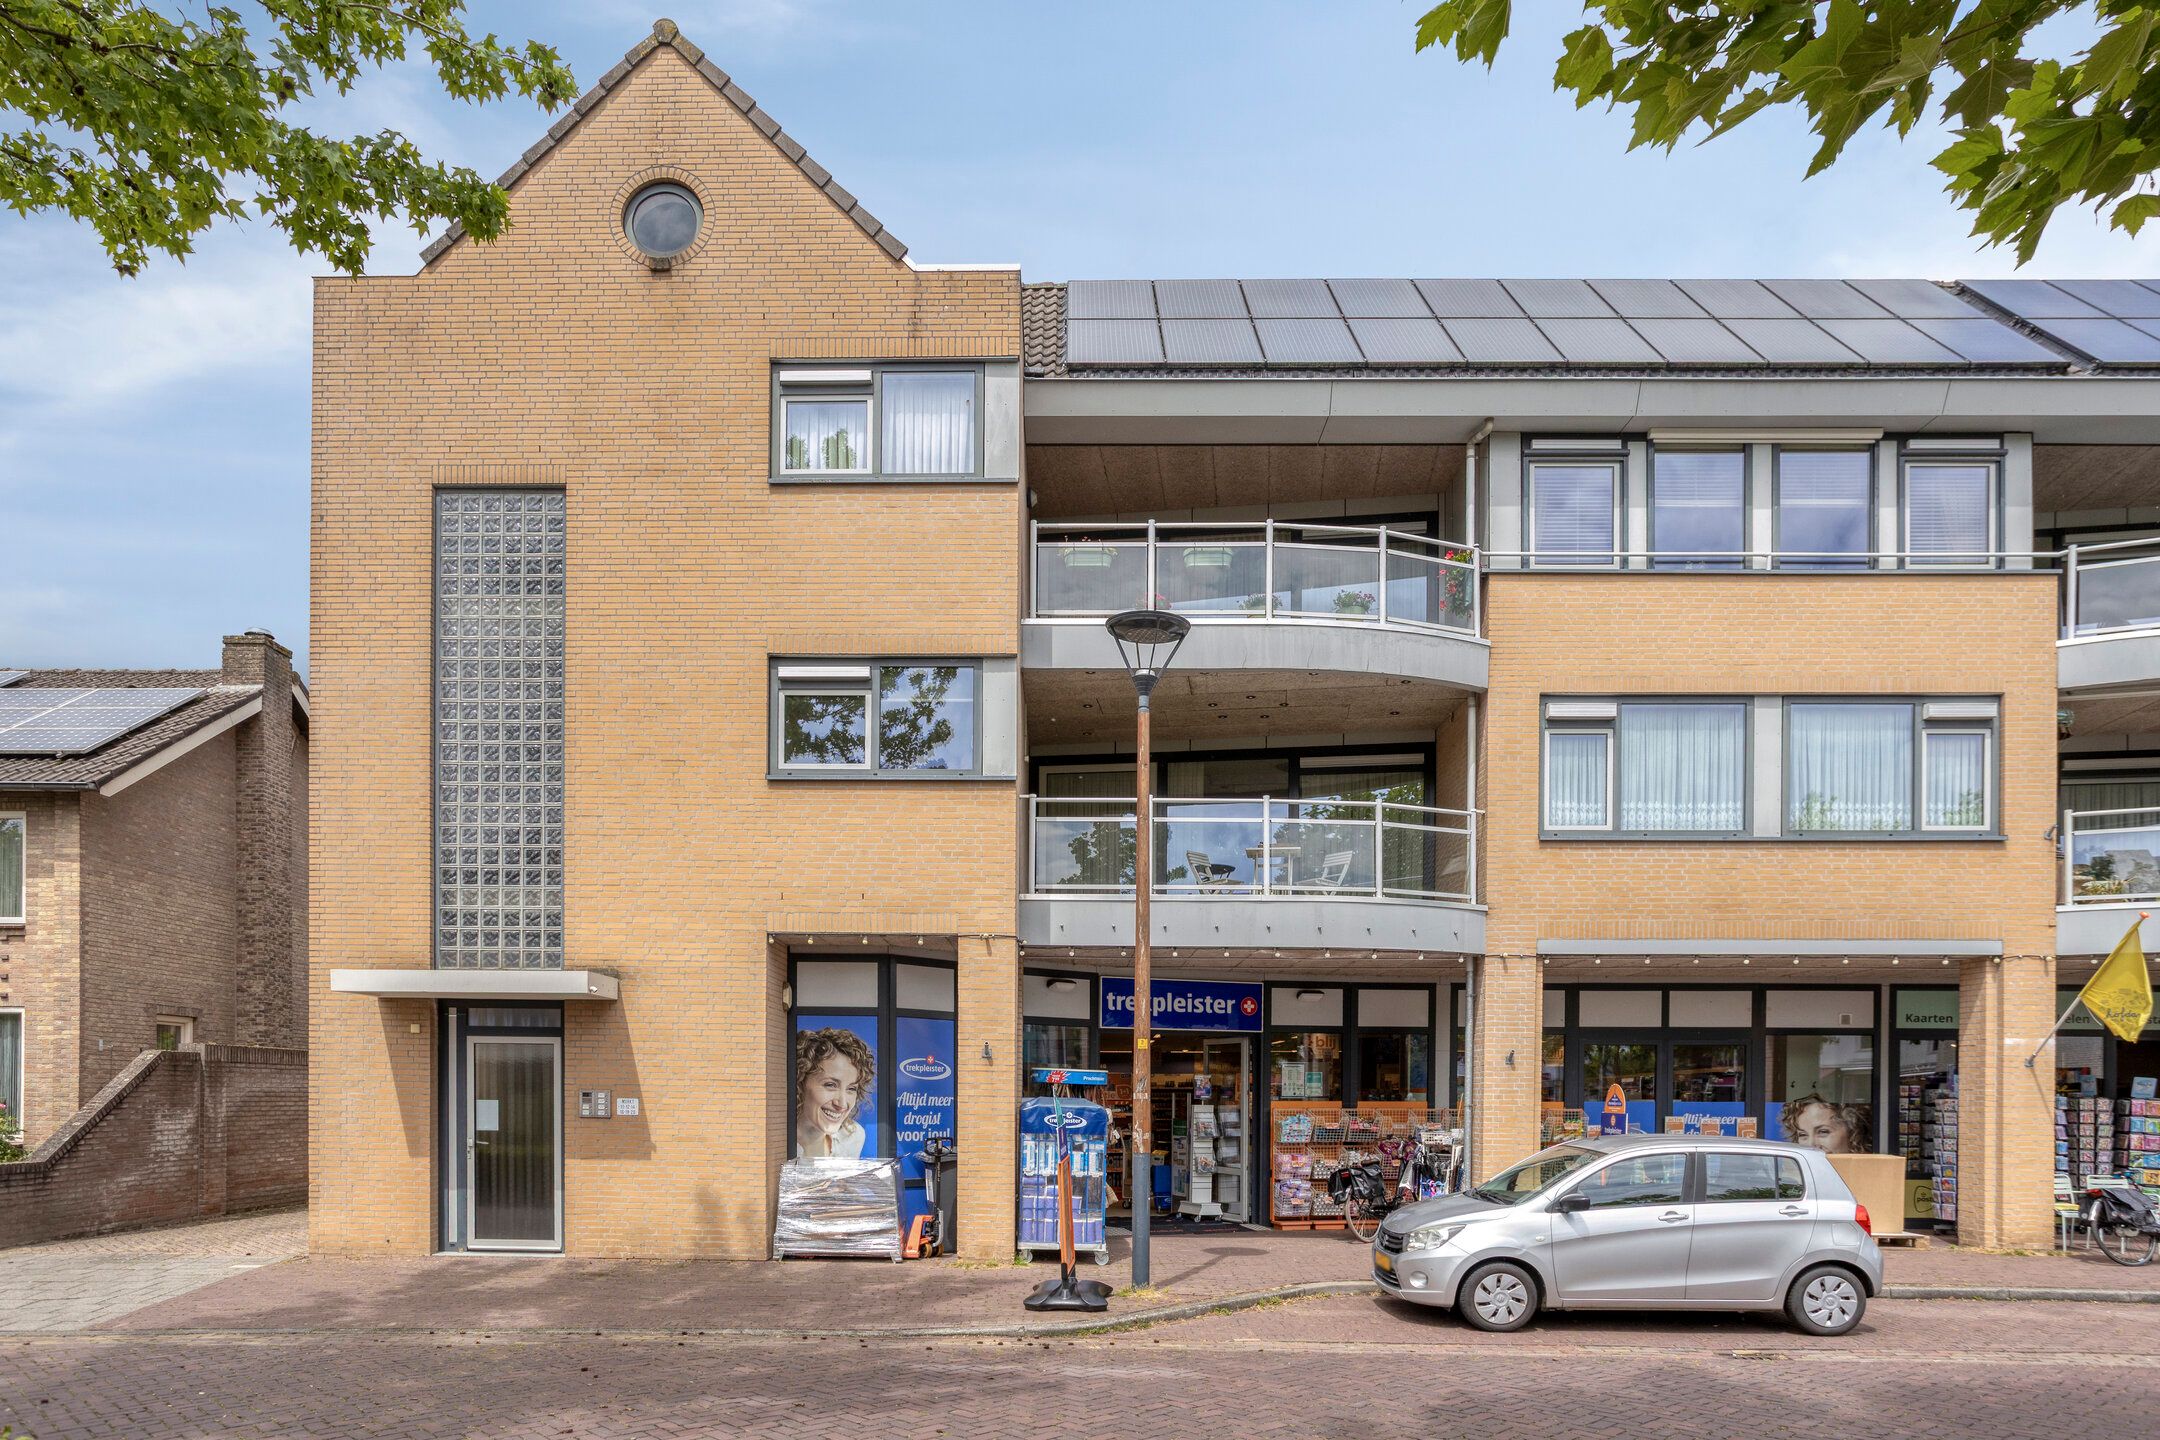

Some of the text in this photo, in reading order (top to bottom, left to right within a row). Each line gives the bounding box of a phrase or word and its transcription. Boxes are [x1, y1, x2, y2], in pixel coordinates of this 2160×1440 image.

[1106, 992, 1236, 1017] trepleister
[1905, 1013, 1953, 1023] Kaarten
[906, 1064, 944, 1073] trekpleister
[896, 1091, 954, 1110] Altijd meer
[903, 1111, 941, 1129] drogist
[896, 1131, 925, 1142] voor
